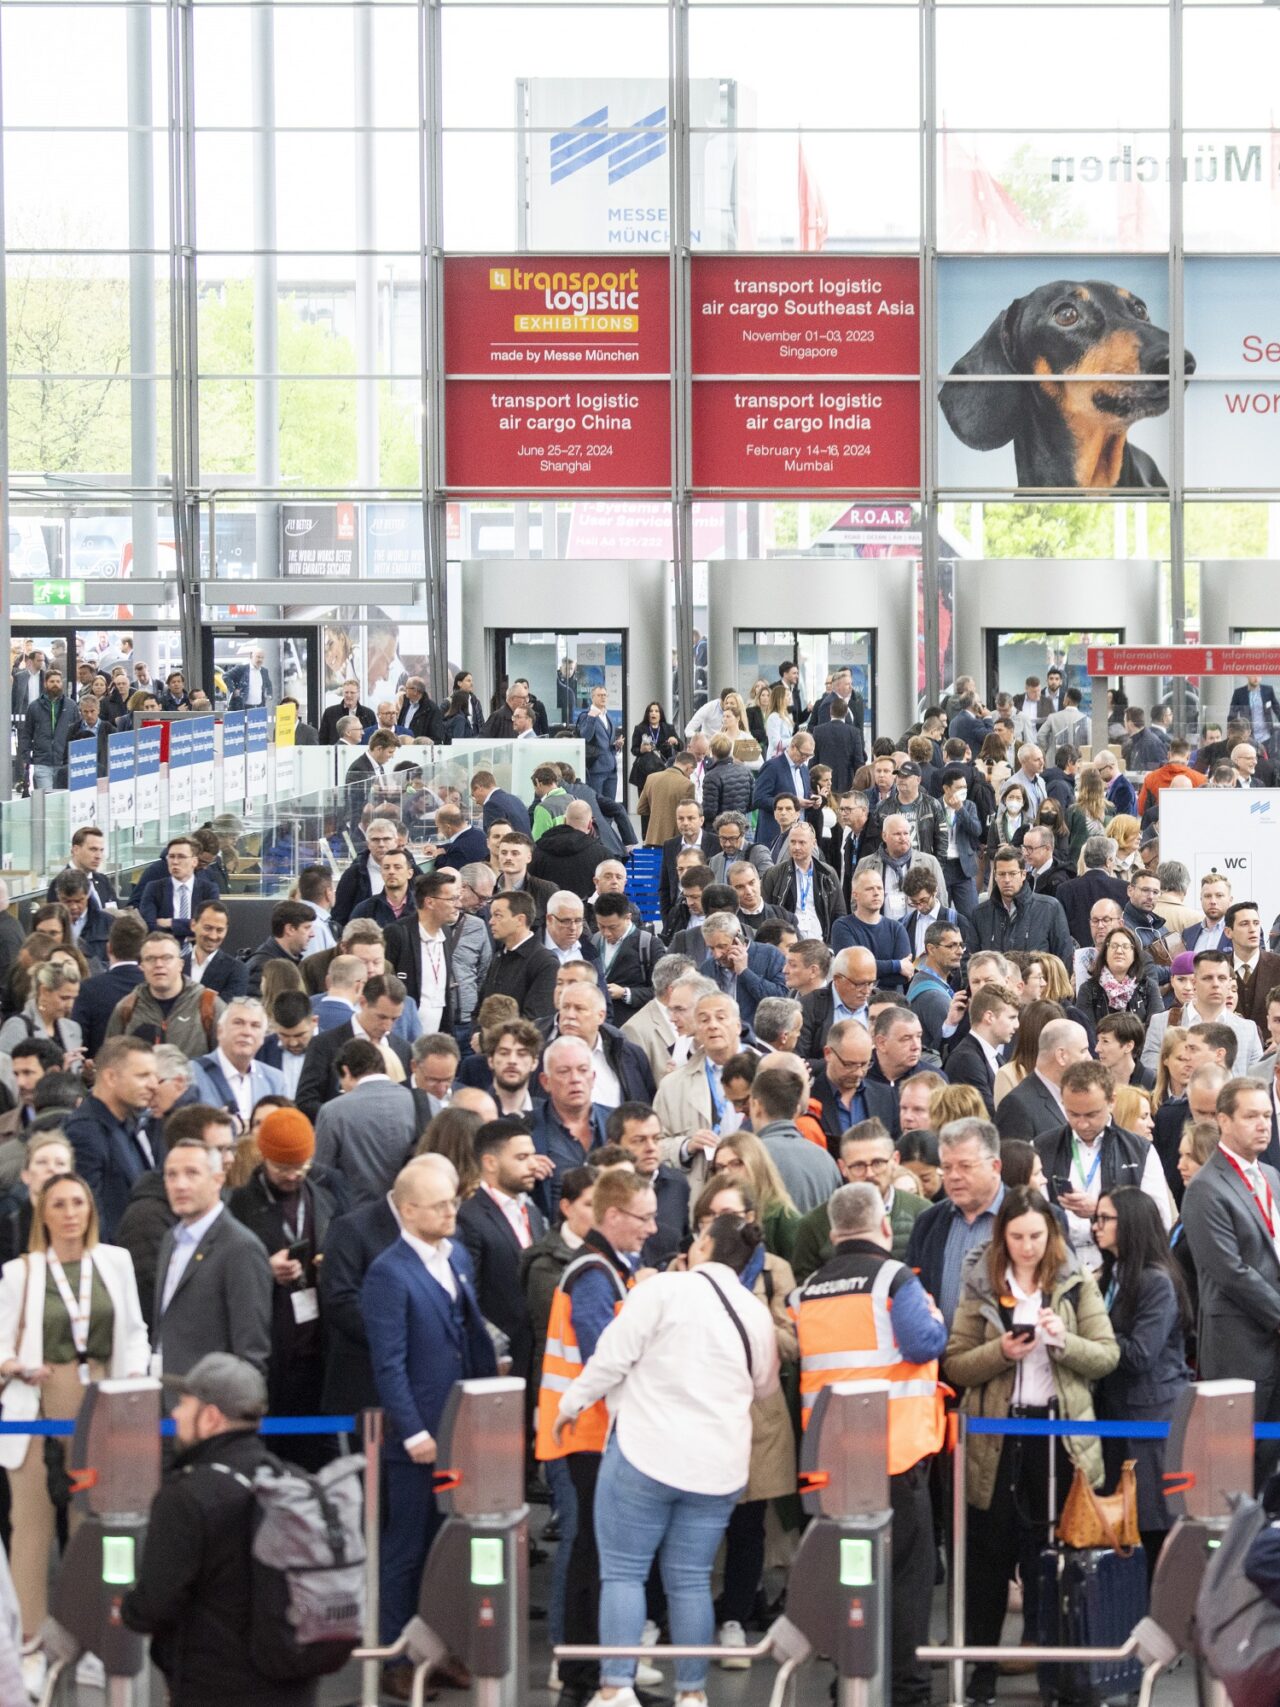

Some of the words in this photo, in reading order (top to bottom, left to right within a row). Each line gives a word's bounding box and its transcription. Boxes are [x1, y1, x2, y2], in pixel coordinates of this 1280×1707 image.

[608, 208, 667, 221] MESSE
[608, 227, 701, 243] MÜNCN
[514, 268, 639, 293] transport
[733, 278, 814, 297] transport
[819, 278, 882, 297] logistic
[545, 288, 639, 316] logistic
[702, 299, 725, 315] air
[729, 303, 779, 319] cargo
[784, 299, 873, 316] Southeast
[876, 299, 915, 316] Asia
[519, 317, 634, 330] EXHIBITIONS
[742, 329, 802, 342] November
[845, 329, 875, 342] 2023
[490, 351, 524, 361] made
[526, 350, 541, 364] by
[543, 351, 583, 361] Messe
[585, 349, 640, 361] München
[779, 345, 838, 360] Singapore
[490, 393, 571, 411] transport
[576, 392, 639, 412] logistic
[734, 393, 815, 412] transport
[819, 392, 883, 412] logistic
[499, 414, 522, 430] air
[526, 417, 576, 433] cargo
[581, 414, 632, 430] China
[745, 414, 769, 430] air
[773, 417, 823, 433] cargo
[828, 414, 872, 430] India
[517, 444, 545, 456] June
[586, 444, 614, 457] 2024
[746, 444, 802, 459] February
[843, 444, 871, 457] 2024
[540, 459, 592, 474] Shanghai
[784, 459, 834, 472] Mumbai
[850, 509, 909, 524] R.O.A.R.
[1113, 650, 1172, 660] Information
[1222, 650, 1280, 660] Information
[1113, 662, 1173, 672] Information
[1222, 662, 1280, 672] Information
[1224, 857, 1248, 869] WC
[804, 1276, 869, 1296] SECURITY
